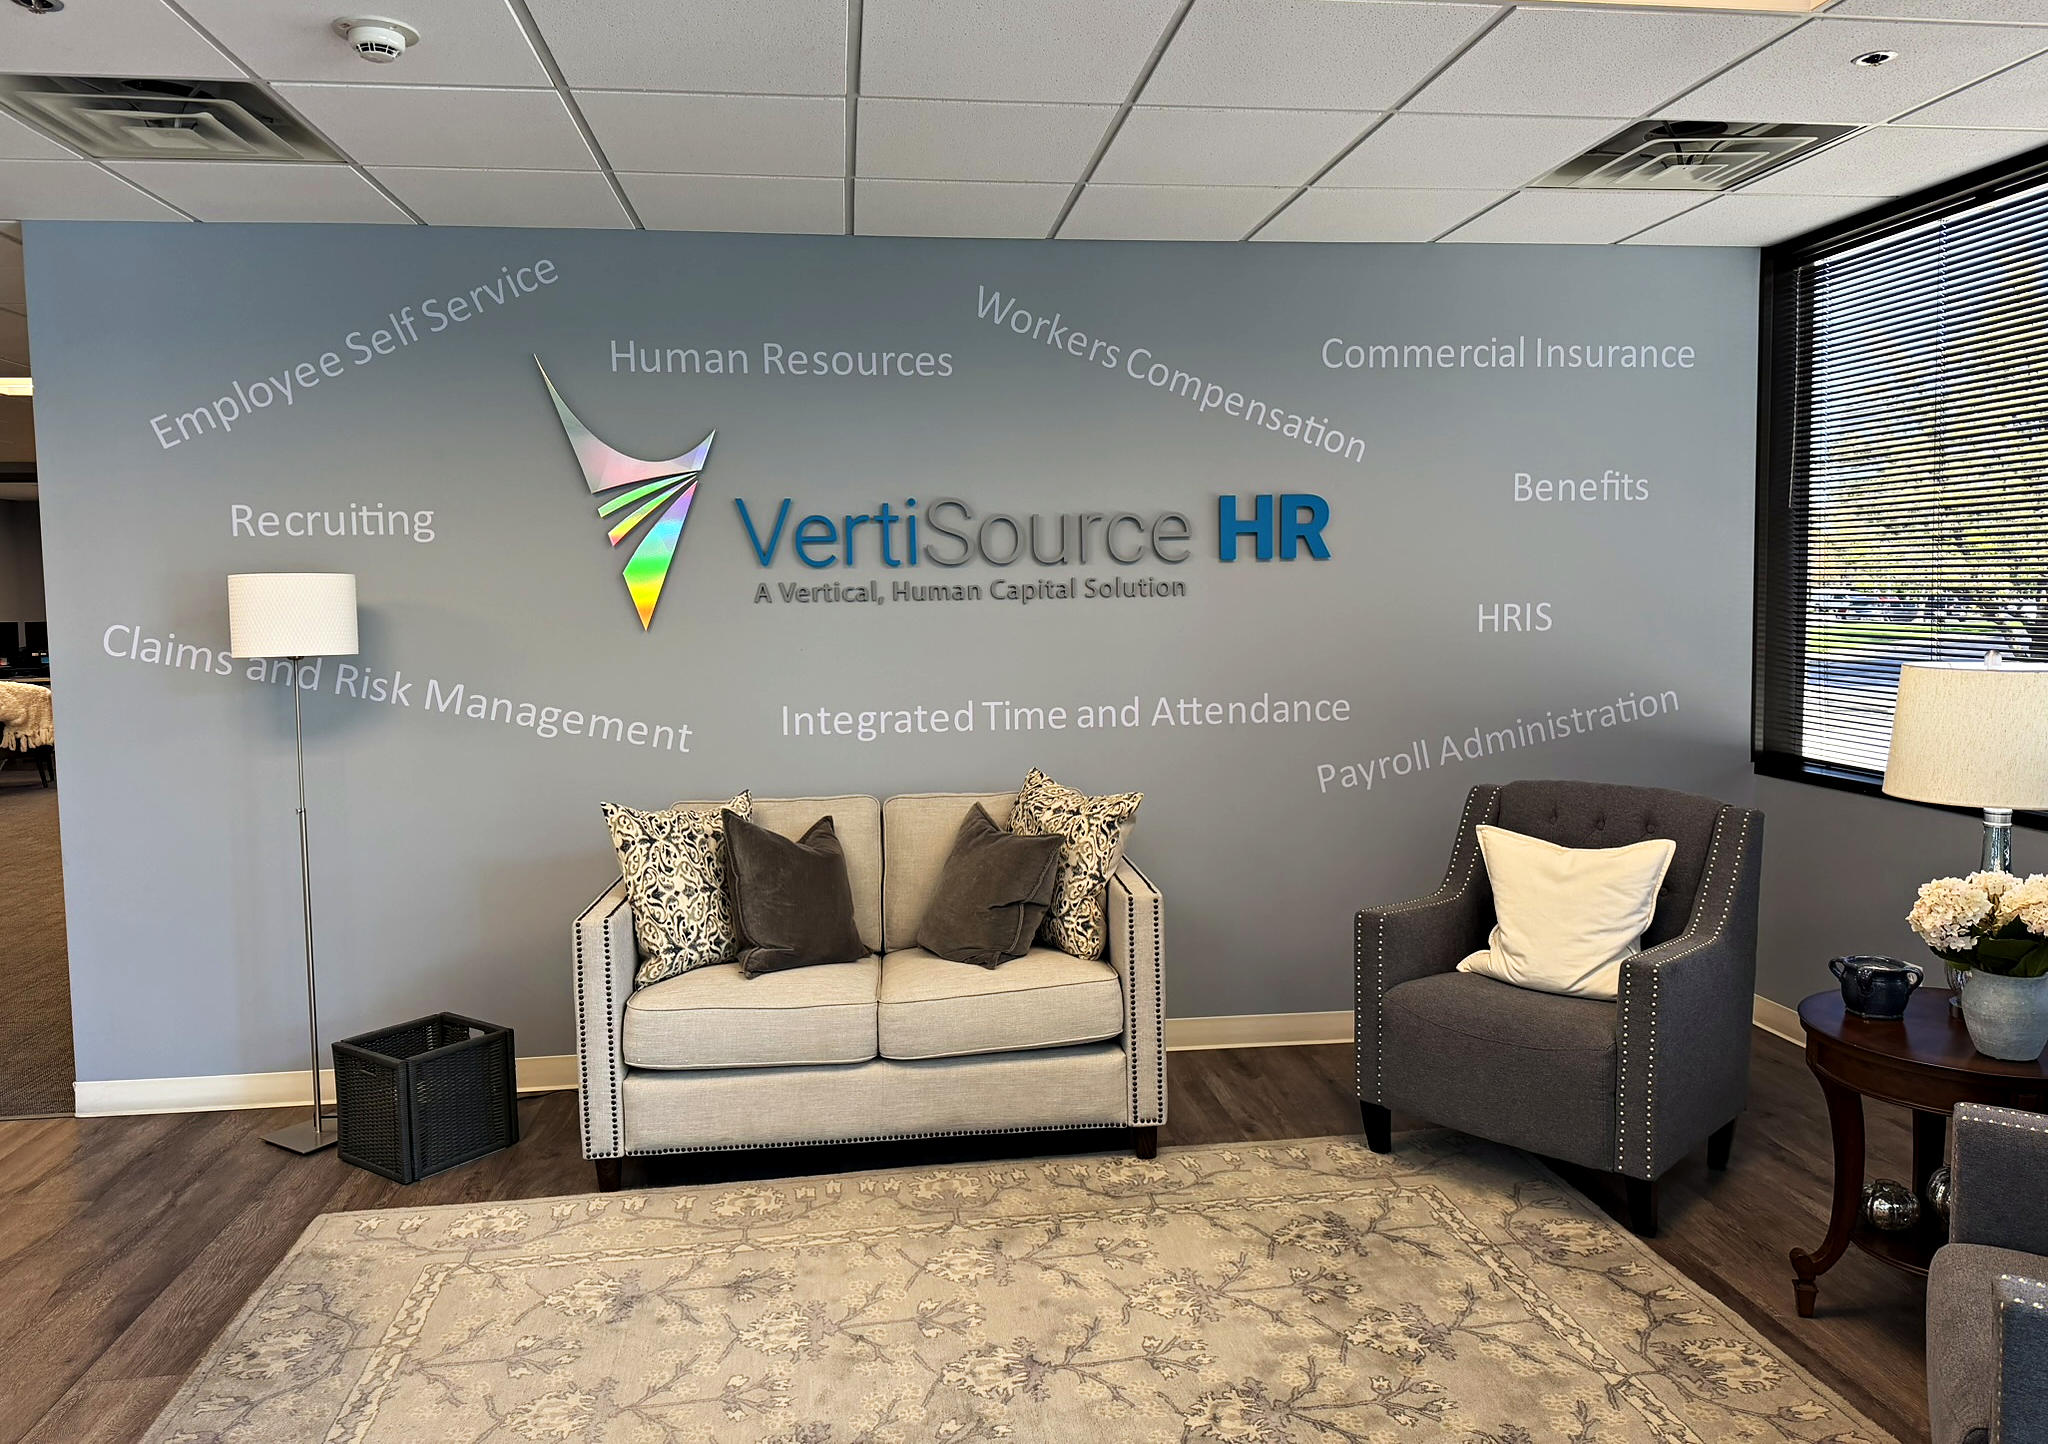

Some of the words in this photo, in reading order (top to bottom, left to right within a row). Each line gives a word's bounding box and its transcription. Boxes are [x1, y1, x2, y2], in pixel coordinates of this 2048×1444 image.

[150, 350, 344, 450] Employee
[345, 305, 419, 366] Self
[421, 256, 559, 332] Service
[611, 340, 749, 374] Human
[762, 343, 953, 377] Resources
[975, 285, 1120, 369] Workers
[1126, 348, 1367, 463] Compensation
[1321, 336, 1525, 369] Commercial
[1536, 337, 1696, 369] Insurance
[1513, 470, 1650, 502] Benefits
[230, 502, 436, 543] Recruiting
[735, 497, 1192, 567] VertiSource
[1217, 493, 1332, 562] HR
[755, 583, 773, 603] A
[779, 578, 884, 605] Vertical,
[892, 579, 982, 601] Human
[990, 576, 1076, 605] Capital
[1084, 575, 1187, 599] Solution
[1477, 602, 1553, 633] HRIS
[102, 623, 233, 676] Claims
[245, 657, 322, 692] and
[335, 663, 412, 708] Risk
[424, 678, 693, 754] Management
[781, 700, 975, 741] Integrated
[981, 701, 1068, 731] Time
[1077, 696, 1141, 729] and
[1150, 692, 1351, 727] Attendance
[1316, 739, 1431, 794] Payroll
[1438, 688, 1681, 767] Administration
